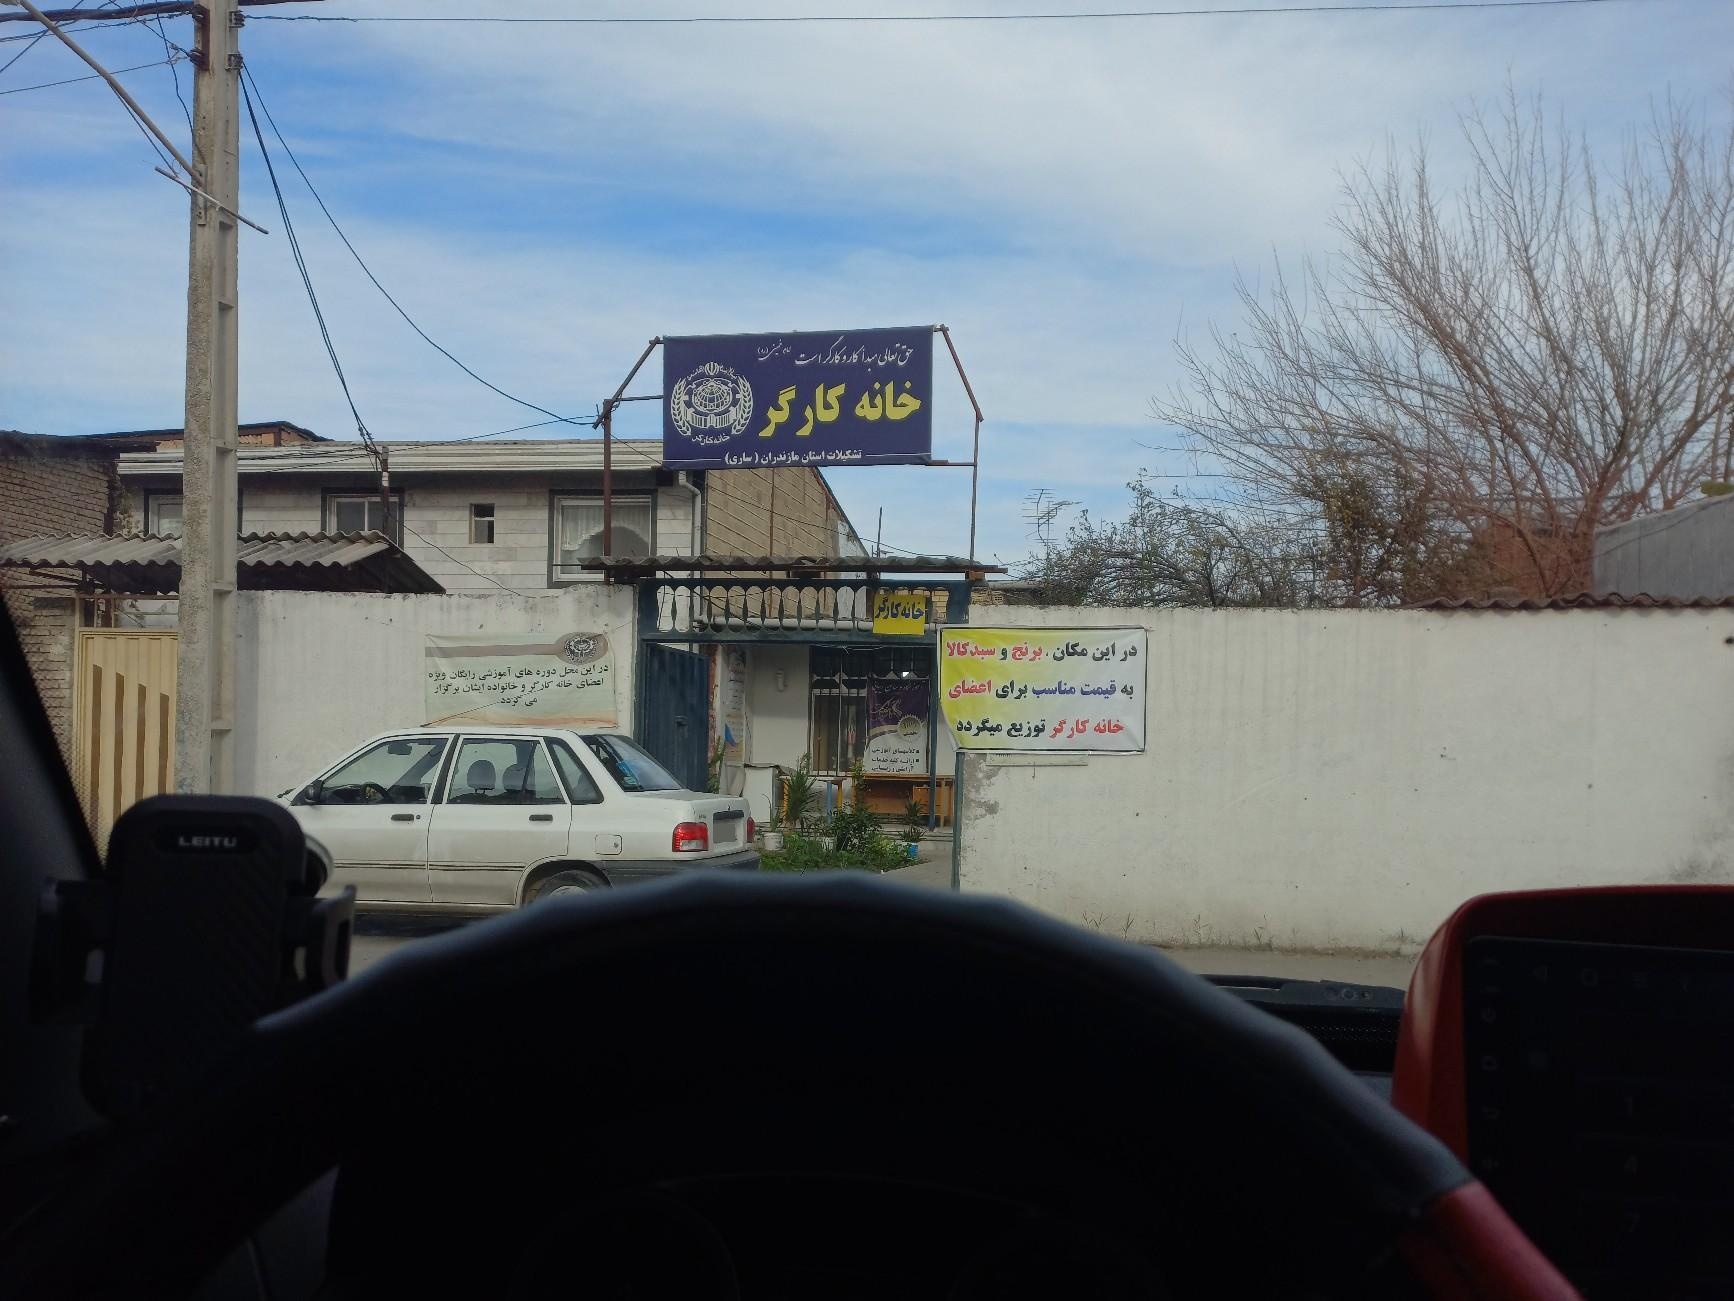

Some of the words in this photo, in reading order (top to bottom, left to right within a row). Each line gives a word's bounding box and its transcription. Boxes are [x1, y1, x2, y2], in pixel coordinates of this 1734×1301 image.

[795, 352, 822, 365] است
[897, 344, 914, 366] حق
[855, 380, 922, 421] خانه
[758, 382, 846, 437] کارگر
[760, 450, 800, 465] مازندران
[801, 450, 825, 463] استان
[826, 449, 863, 462] تشکیلات
[874, 596, 901, 620] کارگر
[901, 601, 925, 620] خانه
[1000, 646, 1008, 661] و
[1010, 641, 1043, 662] برنج
[1092, 642, 1116, 662] این
[1120, 645, 1138, 662] در
[449, 669, 476, 681] رایگان
[478, 666, 512, 680] آموزشی
[514, 667, 533, 679] های
[536, 668, 557, 678] دوره
[559, 666, 579, 678] محل
[580, 664, 596, 676] این
[597, 664, 609, 674] در
[428, 671, 447, 682] ویژه
[555, 679, 573, 688] خانه
[576, 677, 604, 689] اعضای
[462, 682, 485, 694] ایشان
[487, 681, 518, 694] خانواده
[520, 683, 526, 692] و
[528, 680, 554, 693] کارگر
[948, 679, 992, 699] اعضای
[995, 679, 1028, 700] برای
[1031, 680, 1077, 699] مناسب
[1080, 679, 1117, 700] قیمت
[1121, 684, 1135, 700] به
[524, 697, 538, 707] می
[956, 717, 1003, 737] میگردد
[1006, 718, 1046, 738] توزیع
[1049, 718, 1090, 739] کارگر
[1093, 718, 1125, 735] خانه
[178, 836, 238, 847] LEITU
